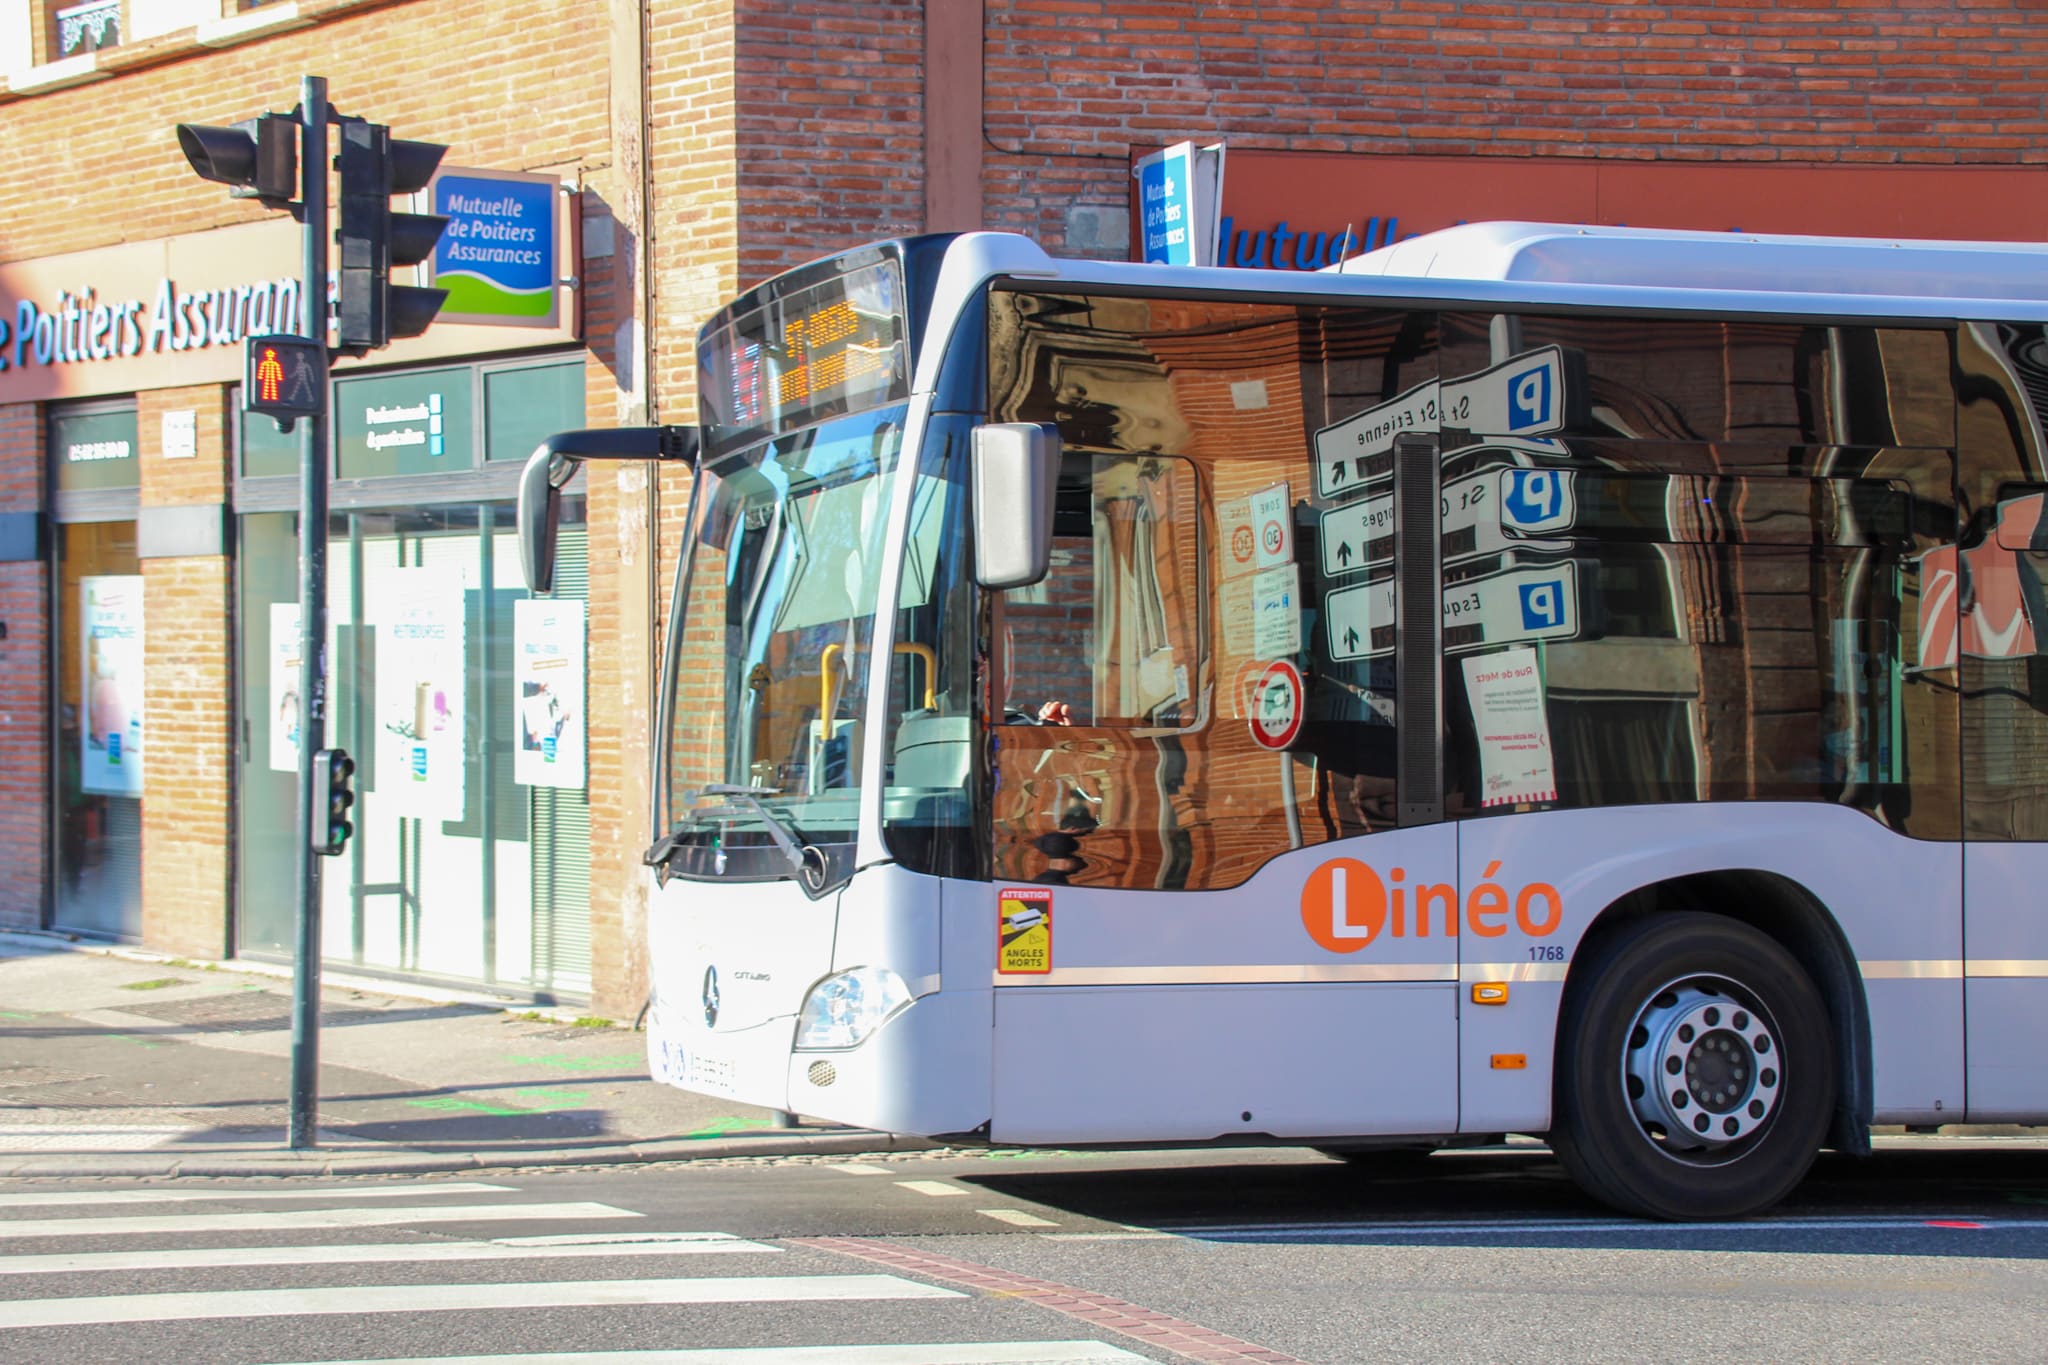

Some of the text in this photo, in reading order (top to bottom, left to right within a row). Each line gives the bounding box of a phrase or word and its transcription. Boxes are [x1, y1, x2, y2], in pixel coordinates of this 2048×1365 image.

[447, 194, 523, 218] Mutuelle
[447, 218, 537, 242] de Poitiers
[1147, 209, 1157, 228] de
[447, 241, 542, 265] Assurances
[1218, 216, 1424, 270] utuell
[13, 285, 144, 367] Poitiers
[1001, 890, 1050, 899] ATTENTION
[1332, 860, 1563, 939] Linéo
[1006, 948, 1044, 958] ANGLES
[1007, 958, 1042, 967] MORTS
[1528, 946, 1565, 961] 1768
